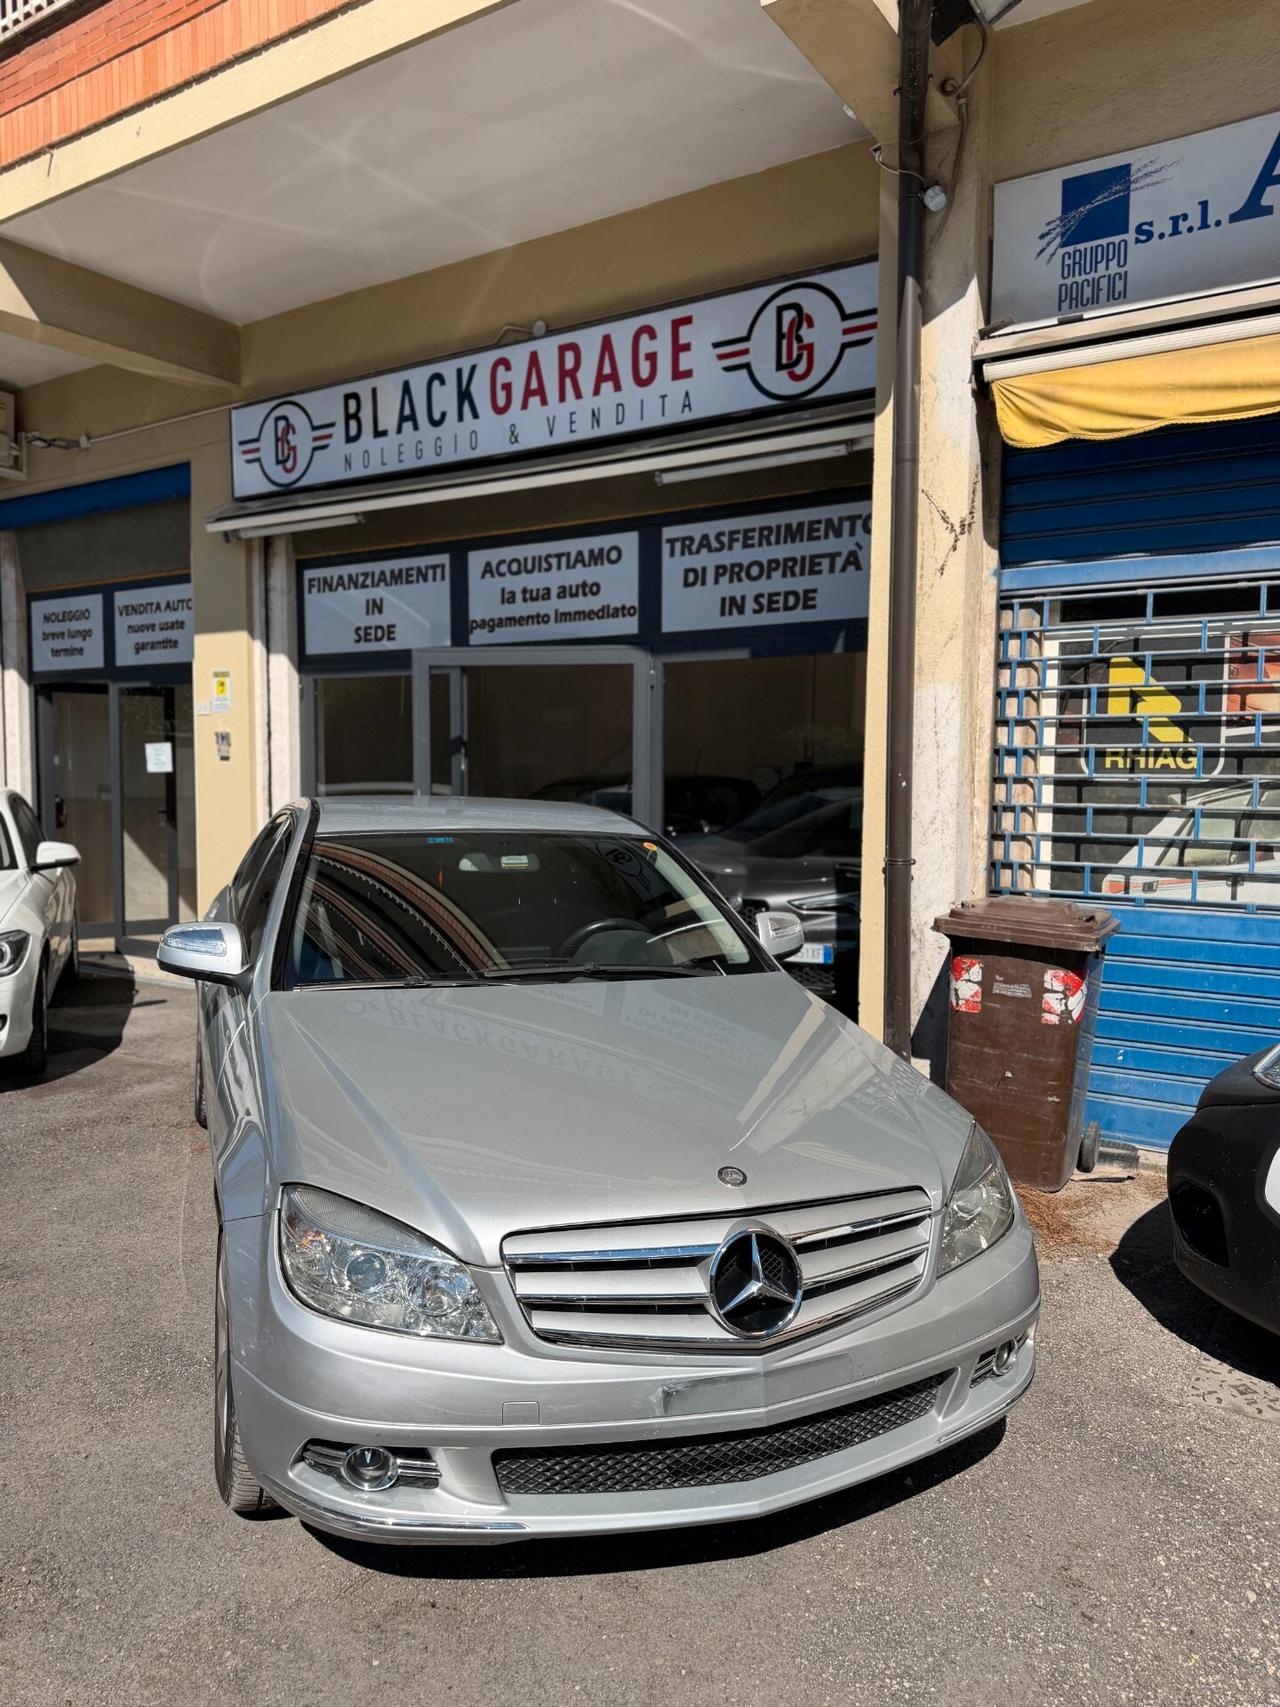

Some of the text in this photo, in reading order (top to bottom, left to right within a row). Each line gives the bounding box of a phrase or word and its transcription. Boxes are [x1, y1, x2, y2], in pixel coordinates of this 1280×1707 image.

[1134, 199, 1222, 245] s.r.l.
[1060, 238, 1128, 280] GRUPPO
[1057, 270, 1128, 312] PACIFICI
[344, 390, 693, 472] NOLEGGIO & VENDITA
[480, 545, 623, 579] ACQUISTIAMO
[683, 541, 863, 588] DI PROPRIETÀ
[307, 563, 446, 595] FINANZIAMENTI
[500, 581, 601, 605] la tua auto
[719, 588, 818, 617] IN SEDE
[43, 609, 91, 624] NOLEGGIO
[118, 601, 162, 617] VENDITA
[365, 598, 384, 616] IN
[127, 619, 186, 634] nuove usate
[469, 608, 551, 635] pagamento
[41, 627, 93, 641] breve lungo
[354, 624, 397, 644] SEDE
[51, 646, 84, 658] termine
[133, 638, 179, 655] garantite
[1104, 748, 1198, 770] RHIAG
